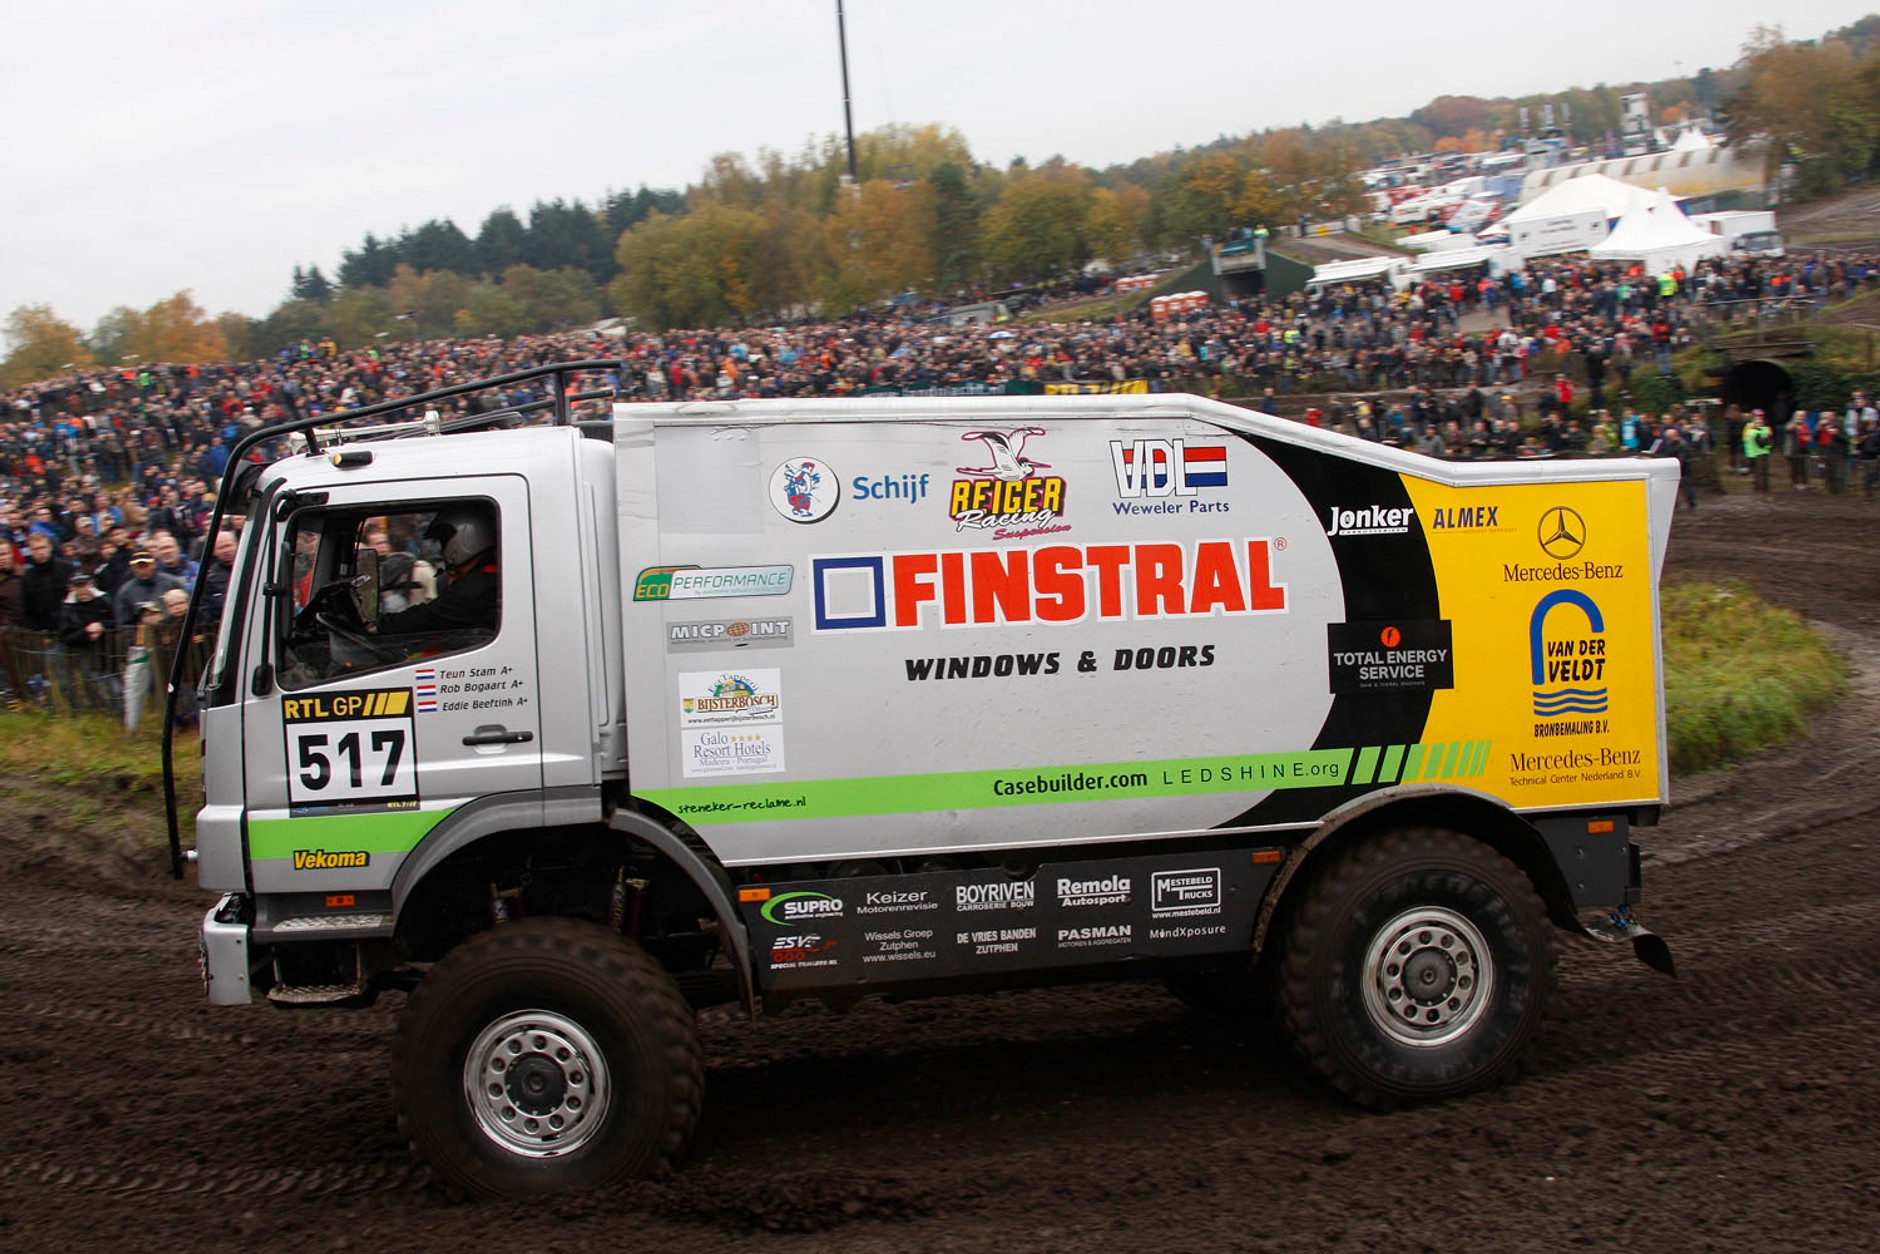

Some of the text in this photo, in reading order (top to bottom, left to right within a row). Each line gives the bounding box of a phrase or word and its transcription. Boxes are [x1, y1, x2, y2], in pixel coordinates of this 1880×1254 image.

[1109, 437, 1198, 498] VDL
[852, 473, 930, 503] Schijf
[950, 477, 1065, 518] REIGER
[1112, 499, 1230, 515] Weweler Parts
[955, 507, 1056, 533] Racing
[1326, 505, 1414, 537] Jonker
[1432, 505, 1499, 529] ALMEX
[992, 523, 1073, 541] Suspension
[1503, 561, 1624, 582] Mercedes-Benz
[635, 584, 670, 599] ECO
[673, 572, 787, 590] PERFORMANCE
[892, 540, 1286, 628] FINSTRAL
[1333, 649, 1448, 666] TOTAL ENERGY
[1547, 639, 1606, 658] VAN DER
[905, 644, 1216, 681] WINDOWS & DOORS
[1548, 658, 1606, 683] VELDT
[439, 666, 513, 679] Teun Stam A+
[1359, 664, 1425, 680] SERVICE
[440, 680, 524, 693] Rob Bogaart A+
[284, 696, 363, 719] RTL GP
[442, 701, 469, 711] Eddie
[516, 696, 528, 706] A+
[696, 694, 776, 711] BIJSTERBOSCH
[1534, 719, 1610, 738] BRONBEMALING B.V.
[700, 730, 729, 746] Galo
[693, 740, 771, 758] Resort Hotels
[297, 729, 406, 791] 517
[1510, 747, 1641, 772] Mercedes-Benz
[993, 773, 1148, 798] Casebuilder.com
[1510, 775, 1547, 787] Technical
[1550, 774, 1577, 784] Center
[1581, 770, 1625, 782] Nederland
[677, 796, 807, 815] steneker-reclame.nl
[294, 848, 369, 870] Vekoma
[956, 881, 1035, 904] BOYRIVEN
[1056, 874, 1131, 895] Remola
[1157, 876, 1213, 902] MESTEBELD
[1171, 885, 1213, 900] TRUCKS
[784, 898, 844, 914] SUPRO
[866, 890, 929, 905] Keizer
[1010, 900, 1035, 908] BOUW
[1061, 894, 1127, 907] Autosport
[856, 901, 939, 914] Motorenrevisie
[1151, 906, 1221, 919] www.mestebeld.nl
[864, 929, 933, 941] Wissels Groep
[956, 927, 1037, 944] DE VRIES BANDEN
[1057, 924, 1132, 941] PASMAN
[879, 941, 919, 951] Zutphen
[975, 942, 1019, 955] ZUTPHEN
[862, 950, 937, 963] www.wissels.eu
